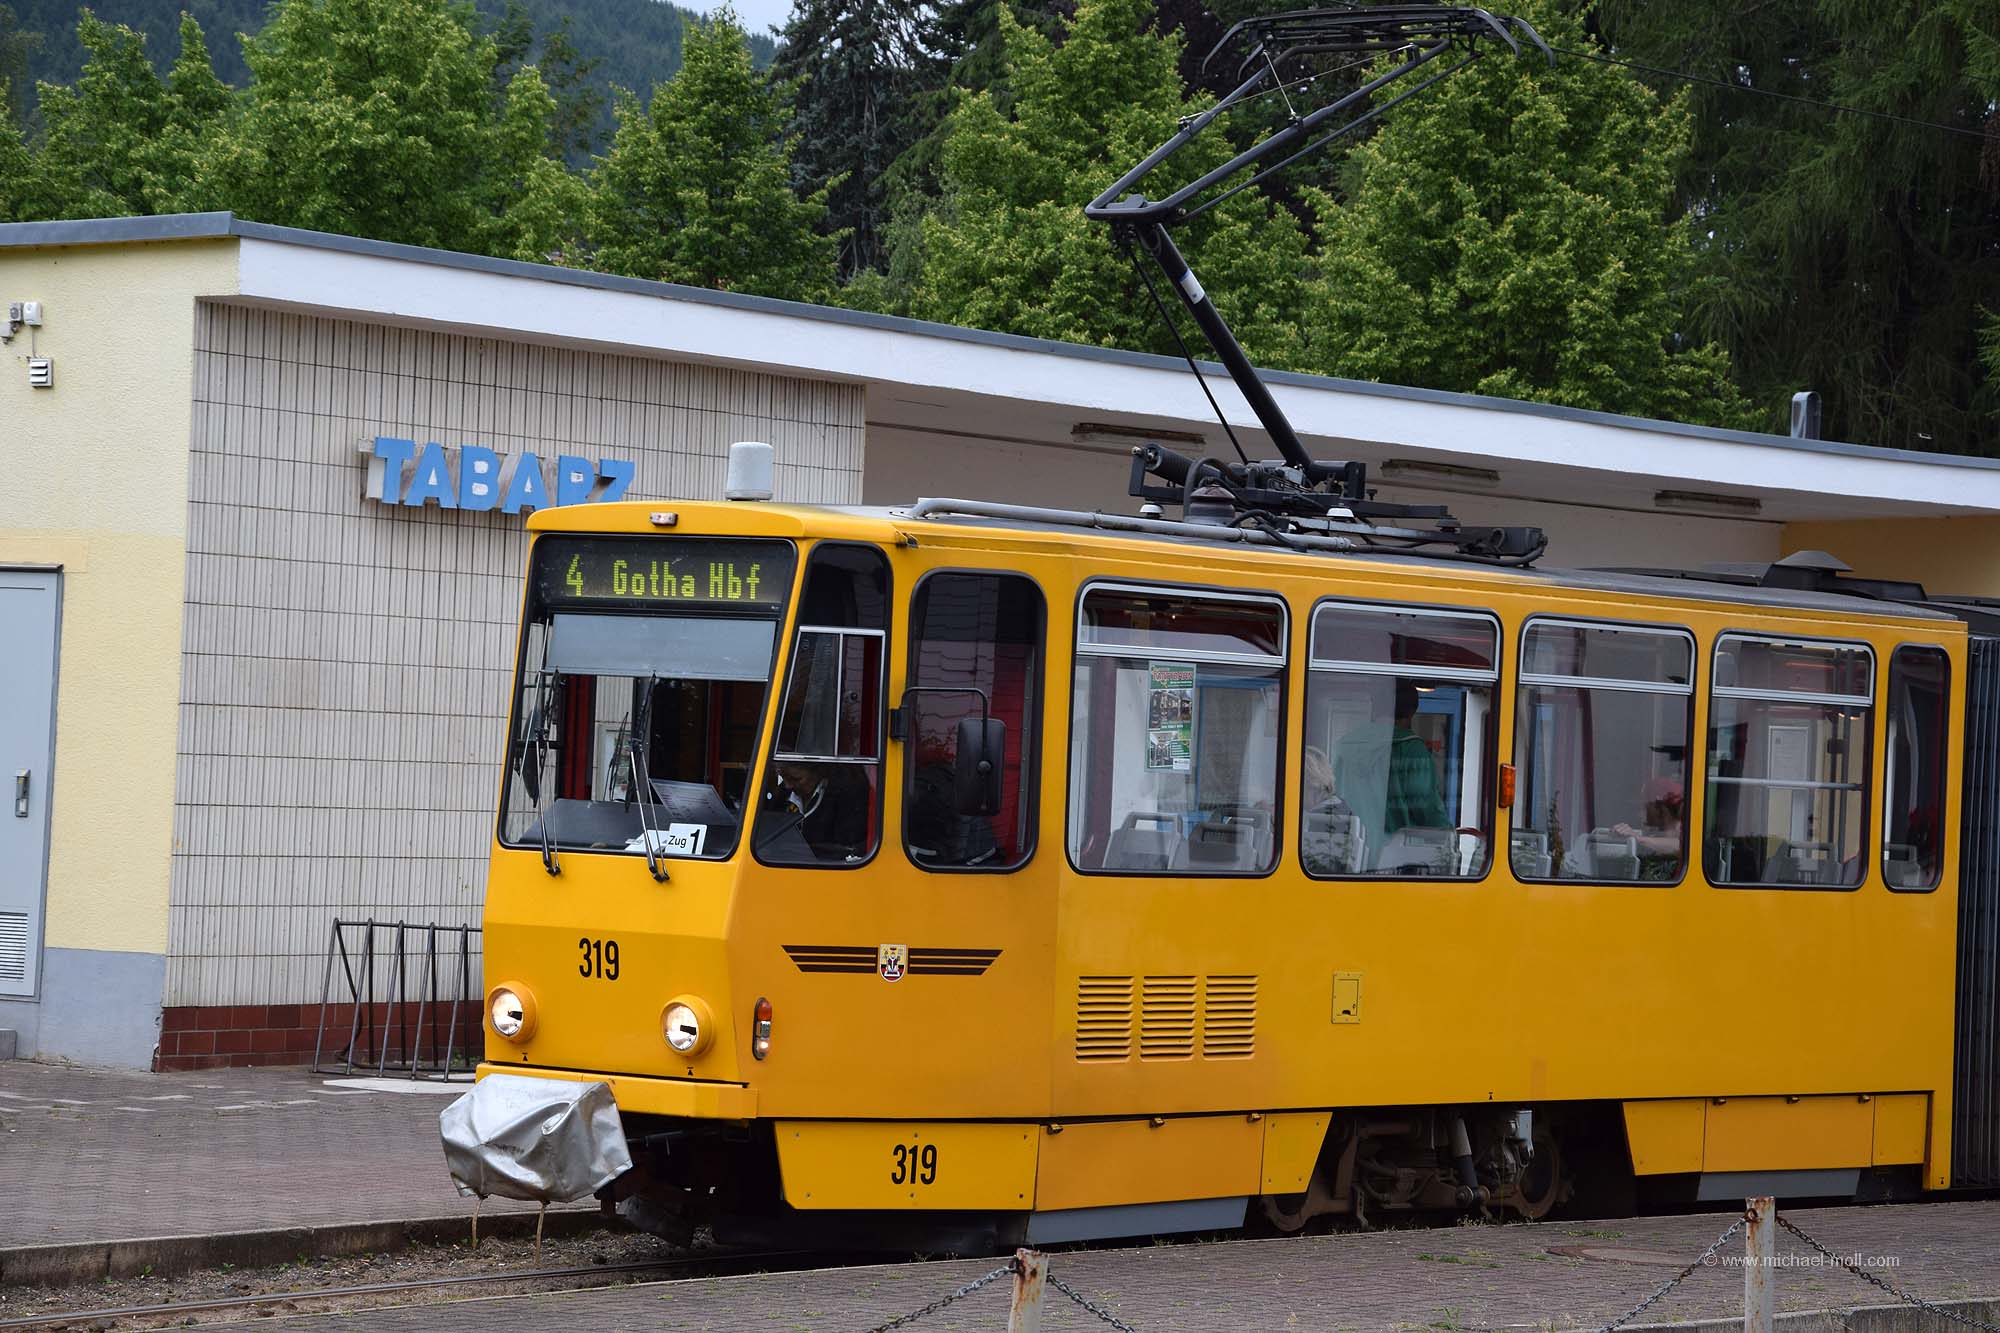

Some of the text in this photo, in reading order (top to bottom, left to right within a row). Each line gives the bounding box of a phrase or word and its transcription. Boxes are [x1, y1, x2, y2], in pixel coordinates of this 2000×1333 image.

[374, 436, 636, 515] TABARZ
[566, 554, 760, 600] 4 Gotha Hbf
[668, 829, 701, 855] Zug 1
[578, 937, 620, 981] 319
[891, 1144, 938, 1185] 319
